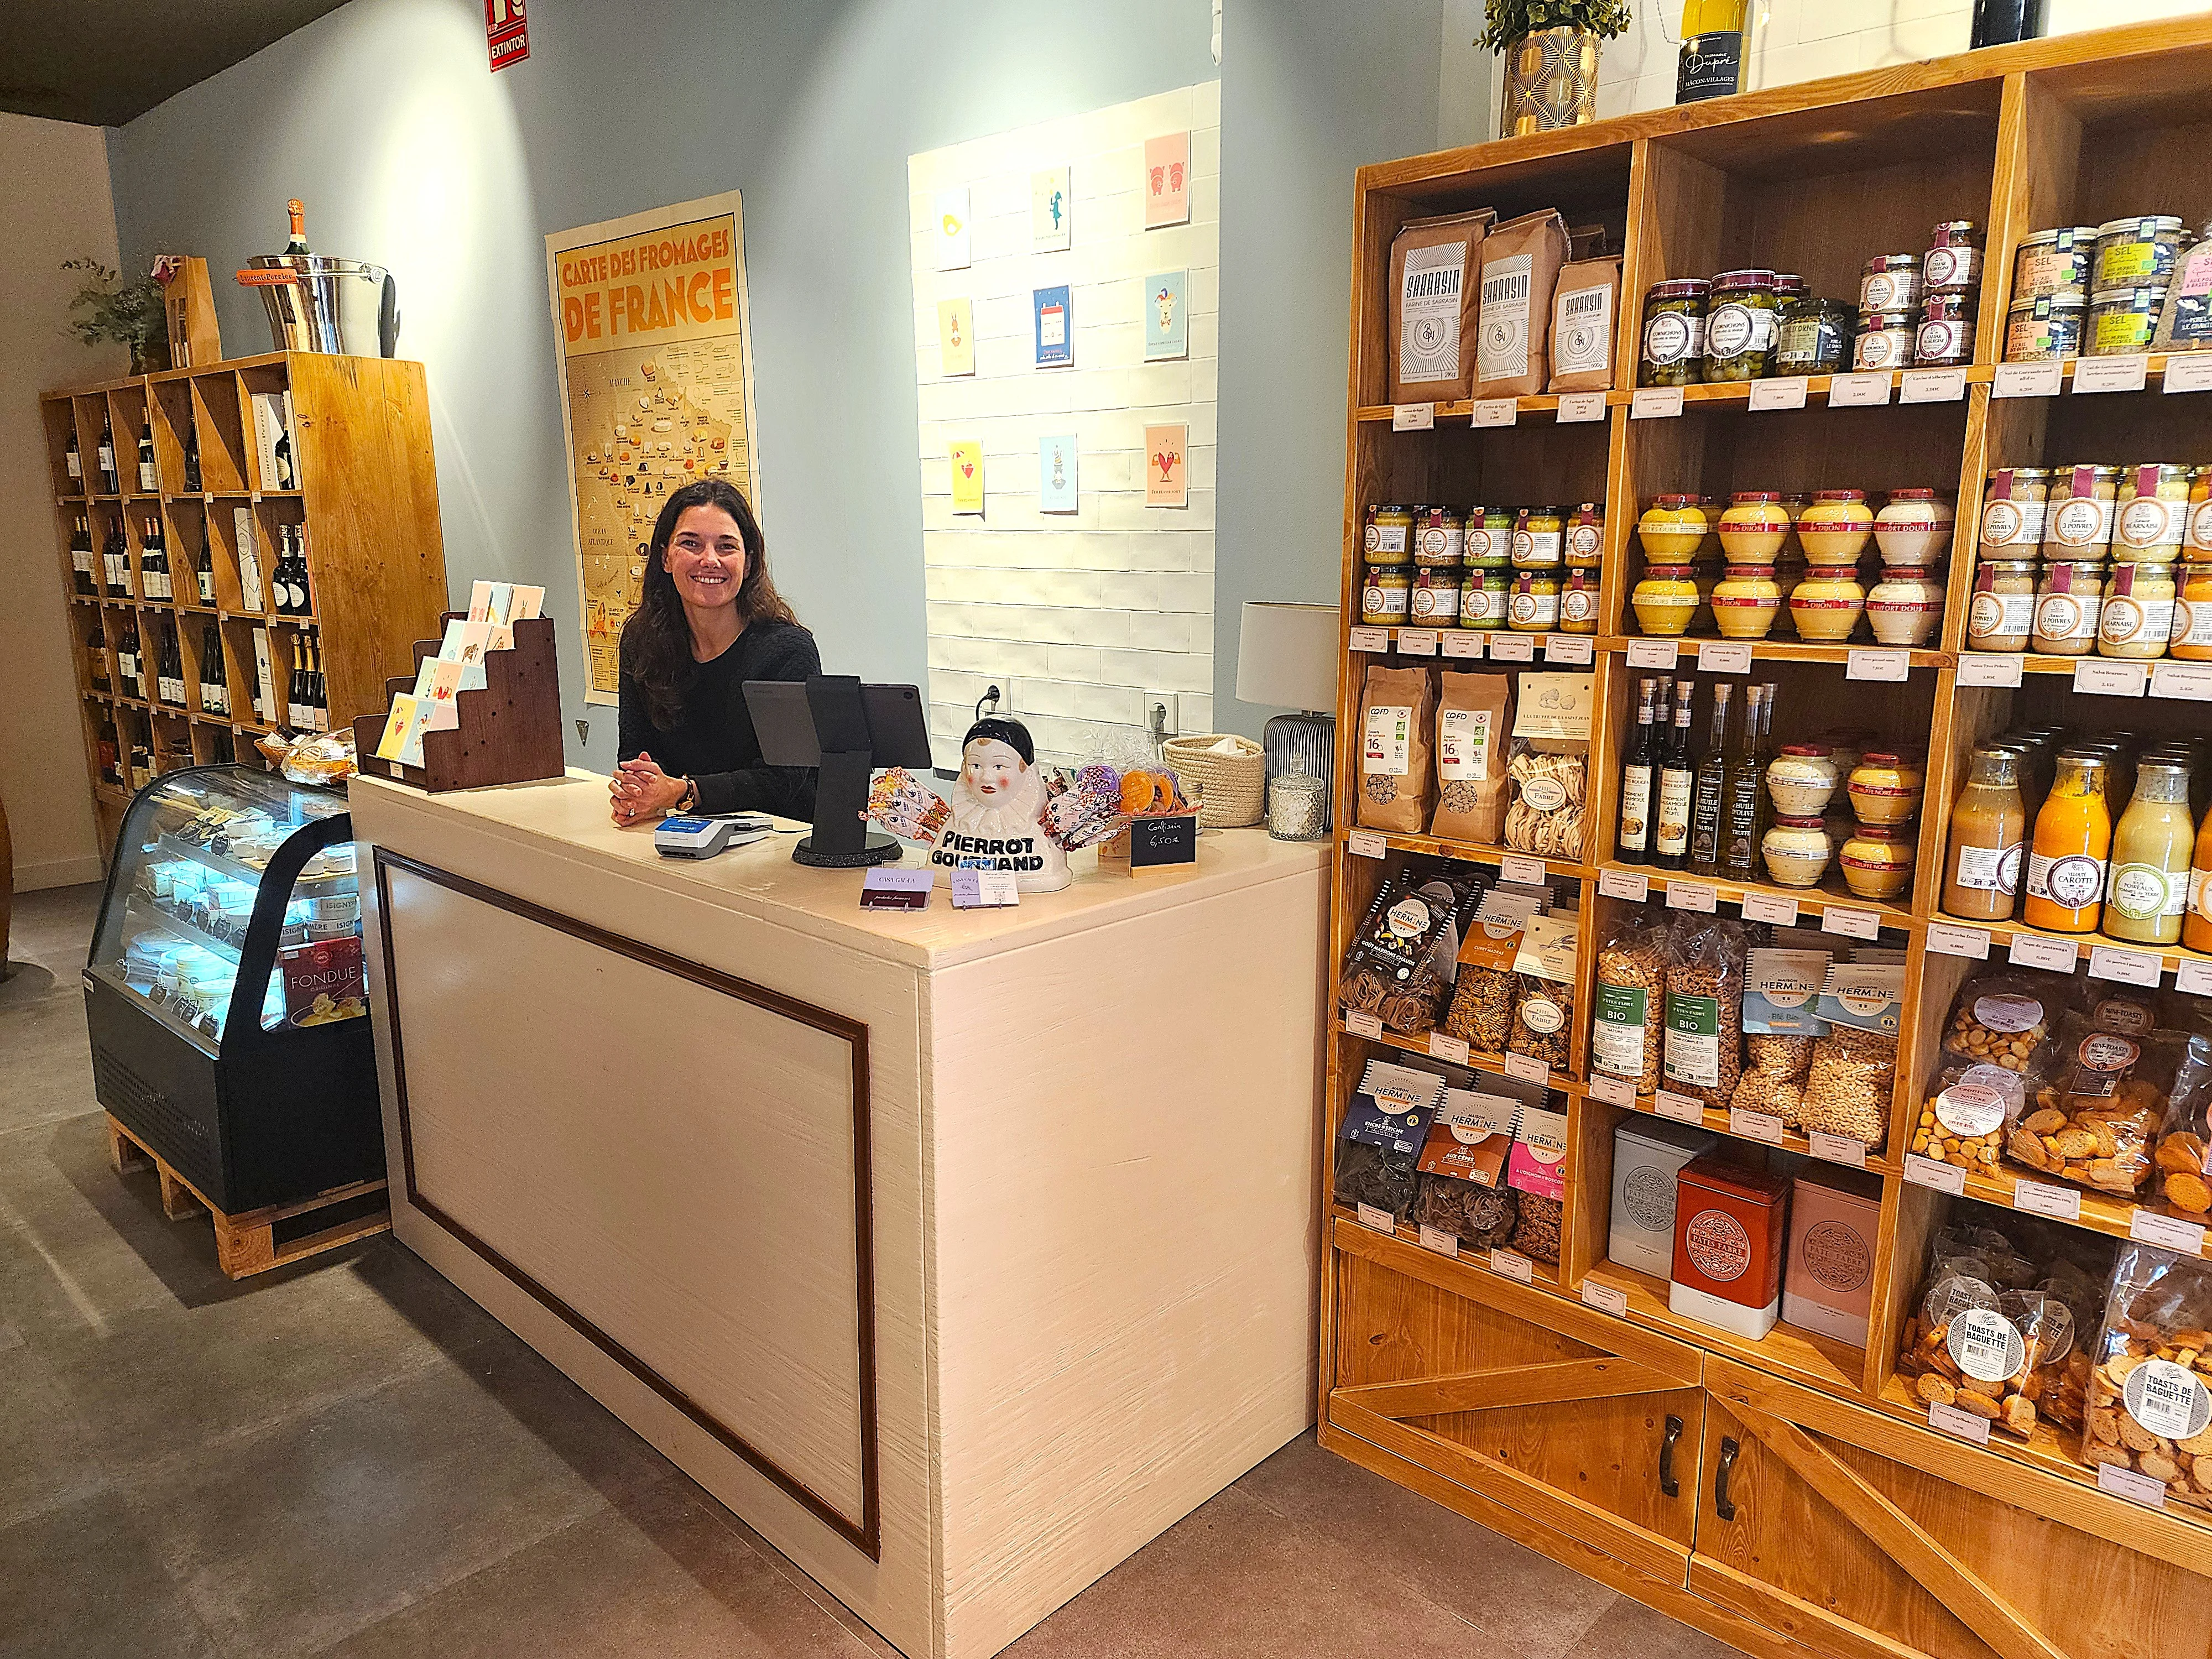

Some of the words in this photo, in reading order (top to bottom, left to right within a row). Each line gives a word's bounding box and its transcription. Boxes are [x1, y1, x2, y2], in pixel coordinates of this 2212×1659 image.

[491, 35, 525, 59] EXTINTOR
[1686, 51, 1738, 74] Dupré
[562, 257, 607, 288] CARTE
[611, 248, 635, 279] DES
[639, 228, 729, 273] FROMAGES
[2115, 247, 2131, 255] SEL
[239, 273, 293, 283] Laurent-Perrier
[1406, 269, 1460, 298] SARRASIN
[1483, 274, 1527, 305] SARRASIN
[564, 291, 602, 343] DE
[608, 267, 734, 337] FRANCE
[1566, 293, 1603, 316] SARRASIN
[2110, 315, 2126, 325] SEL
[2015, 324, 2028, 333] SEL
[1446, 712, 1467, 720] CQFD
[1367, 738, 1379, 750] 16
[1443, 743, 1455, 755] 16
[942, 830, 1034, 855] PIERROT
[1150, 835, 1180, 848] 6,50€
[2058, 875, 2093, 885] CAROTTE
[2124, 883, 2154, 891] POIREAUX
[1361, 940, 1374, 949] GOÛT
[1374, 945, 1397, 958] MARRONS
[1396, 953, 1416, 967] CHAUDS
[291, 967, 357, 989] FONDUE
[1531, 1015, 1552, 1025] FABRE
[1607, 1010, 1626, 1021] BIO
[1679, 1020, 1699, 1031] BIO
[1960, 1094, 1986, 1103] NATURE
[1364, 1120, 1382, 1129] ENCRE
[1385, 1125, 1405, 1135] SEICHE
[1717, 1241, 1743, 1256] FABRE
[1967, 1322, 1996, 1338] TOASTS
[1997, 1331, 2007, 1342] DE
[1966, 1331, 2006, 1350] BAGUETTE
[2148, 1375, 2179, 1392] TOASTS
[2182, 1386, 2193, 1397] DE
[2146, 1384, 2192, 1406] BAGUETTE
